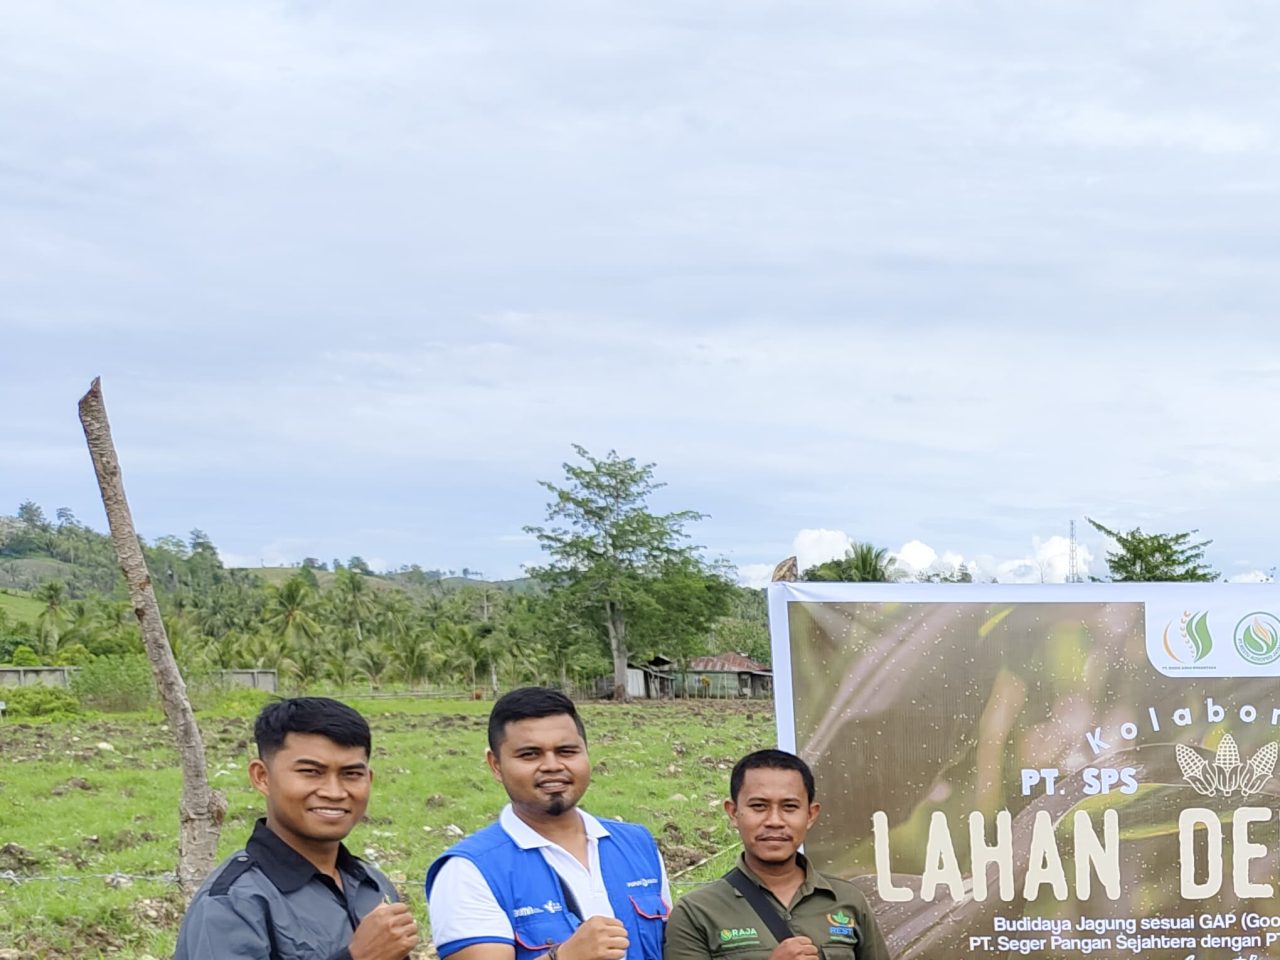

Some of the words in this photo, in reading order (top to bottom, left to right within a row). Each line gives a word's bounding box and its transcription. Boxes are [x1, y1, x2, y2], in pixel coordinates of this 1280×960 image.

[1020, 769, 1066, 796] PT.
[1082, 768, 1139, 795] SPS
[872, 807, 1121, 902] LAHAN
[731, 927, 758, 937] RAJA
[993, 916, 1072, 934] Budidaya
[1075, 916, 1137, 934] Jagung
[1140, 915, 1195, 930] sesuai
[1199, 914, 1237, 930] GAP
[968, 936, 994, 951] PT.
[997, 936, 1047, 954] Seger
[1050, 935, 1111, 954] Pangan
[1115, 934, 1196, 953] Sejahtera
[1200, 933, 1261, 951] dengan
